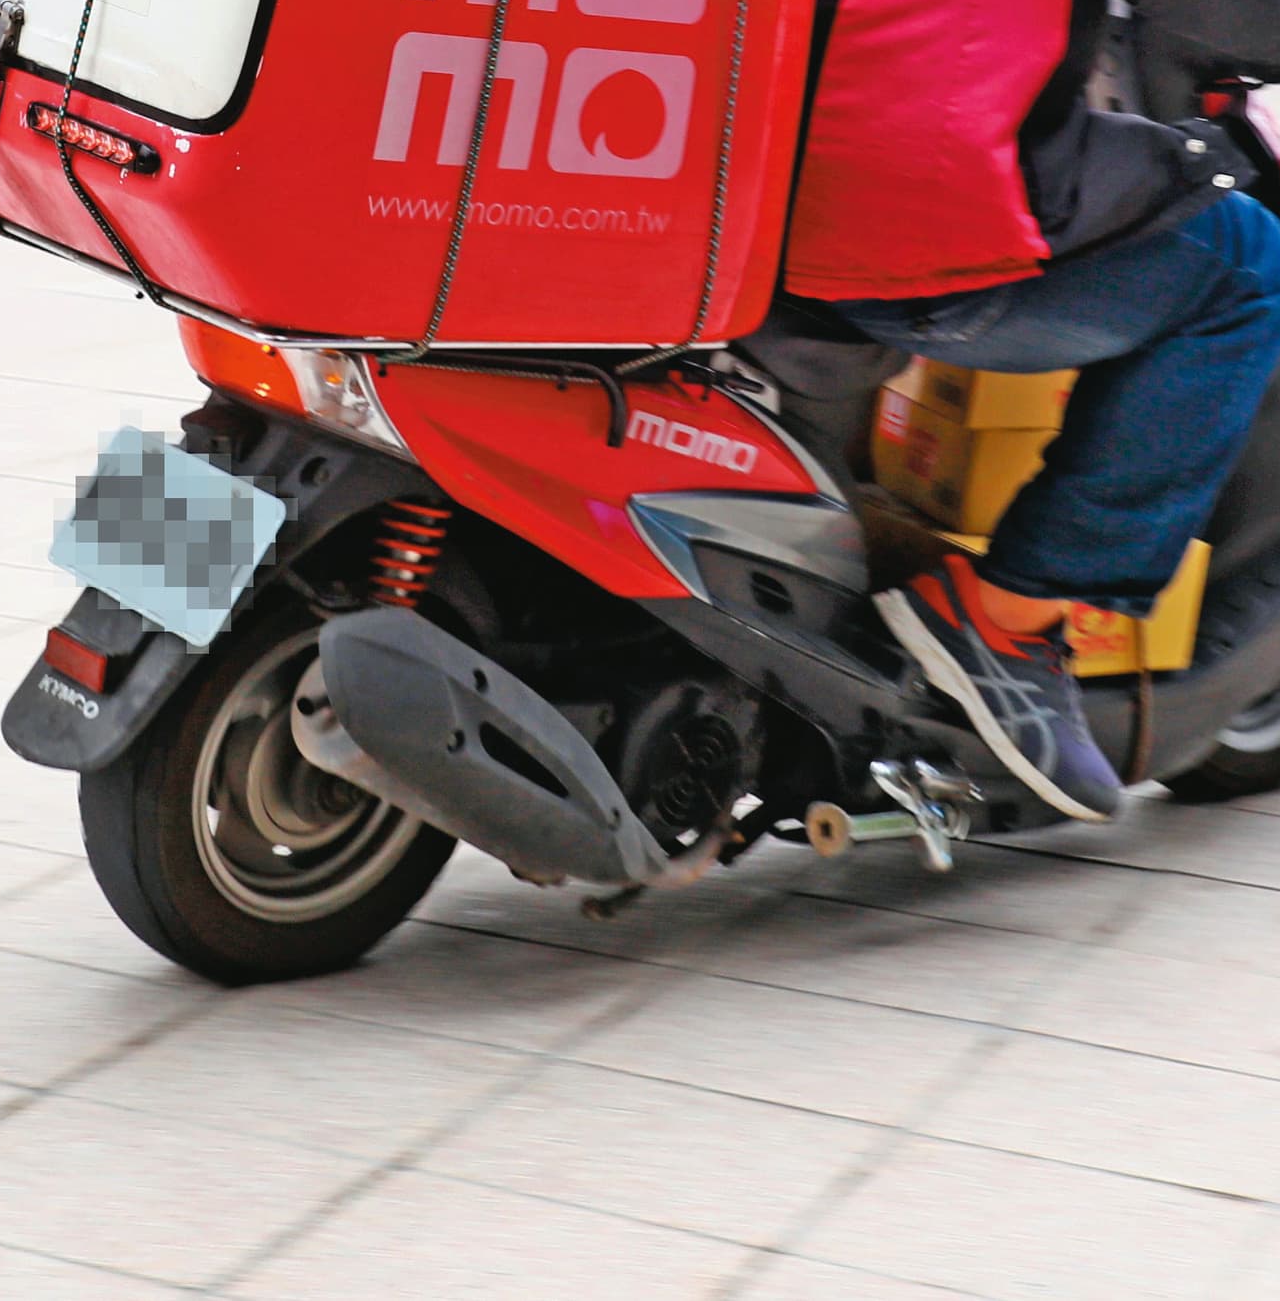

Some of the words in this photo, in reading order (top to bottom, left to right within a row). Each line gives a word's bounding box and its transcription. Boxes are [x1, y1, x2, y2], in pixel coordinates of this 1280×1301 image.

[373, 31, 697, 179] mo
[368, 195, 671, 234] www.momo.com.tw
[626, 409, 759, 475] momo
